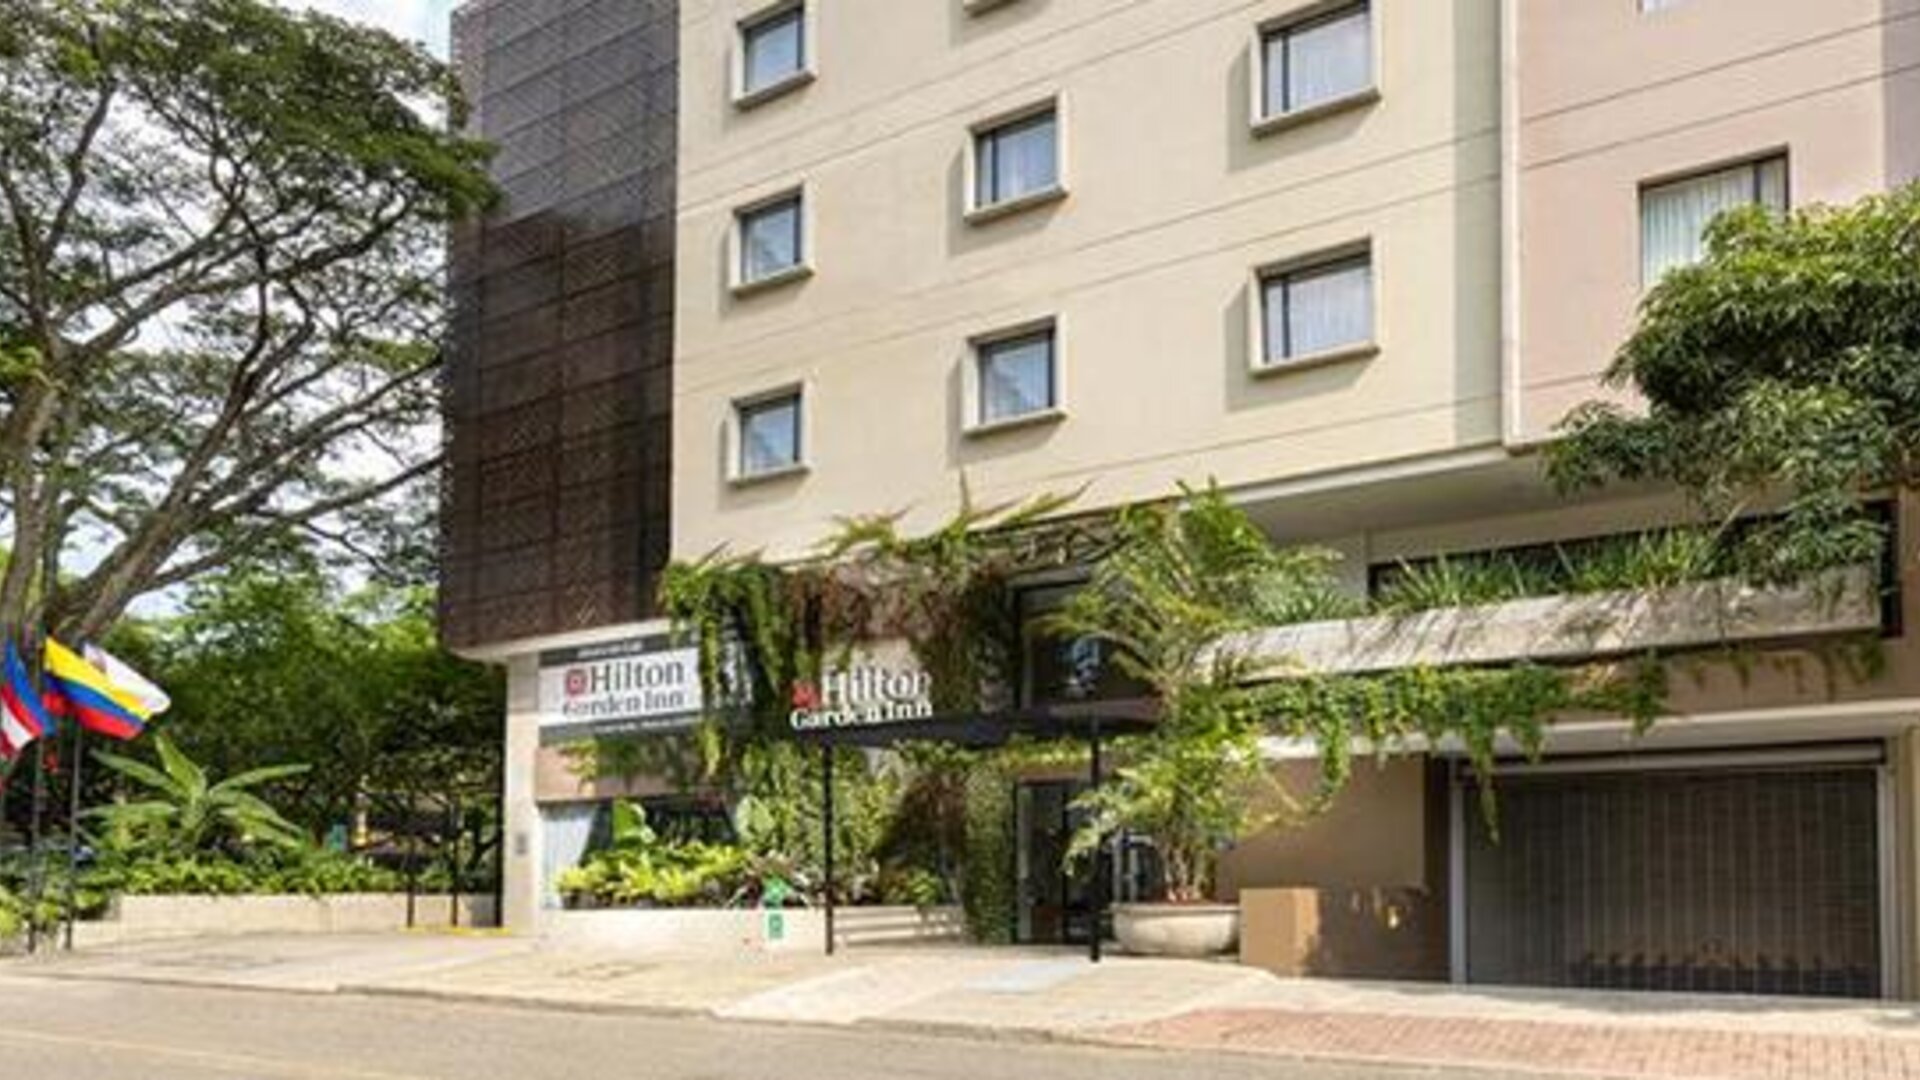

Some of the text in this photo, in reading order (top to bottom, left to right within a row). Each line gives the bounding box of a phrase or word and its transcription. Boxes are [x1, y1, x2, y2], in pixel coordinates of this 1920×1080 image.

[590, 661, 684, 694] Hilton
[822, 666, 932, 707] Hilton
[562, 690, 684, 717] Garden Inn
[789, 698, 933, 730] Garden Inn
